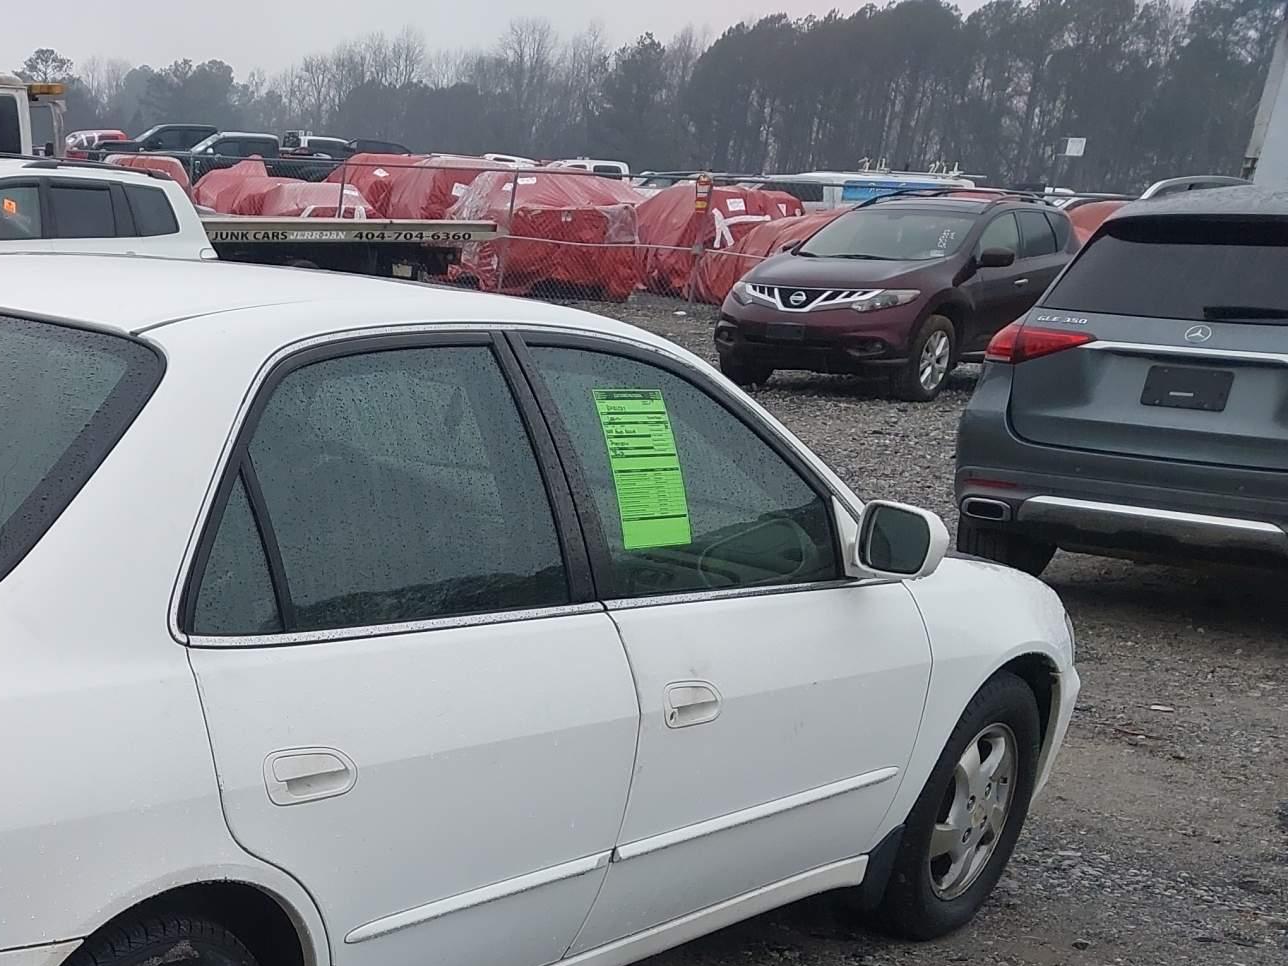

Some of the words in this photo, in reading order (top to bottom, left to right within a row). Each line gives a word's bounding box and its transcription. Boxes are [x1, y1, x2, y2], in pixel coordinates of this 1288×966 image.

[212, 231, 249, 241] JUNK
[253, 231, 288, 241] CARS
[353, 231, 472, 241] 404-704-6360
